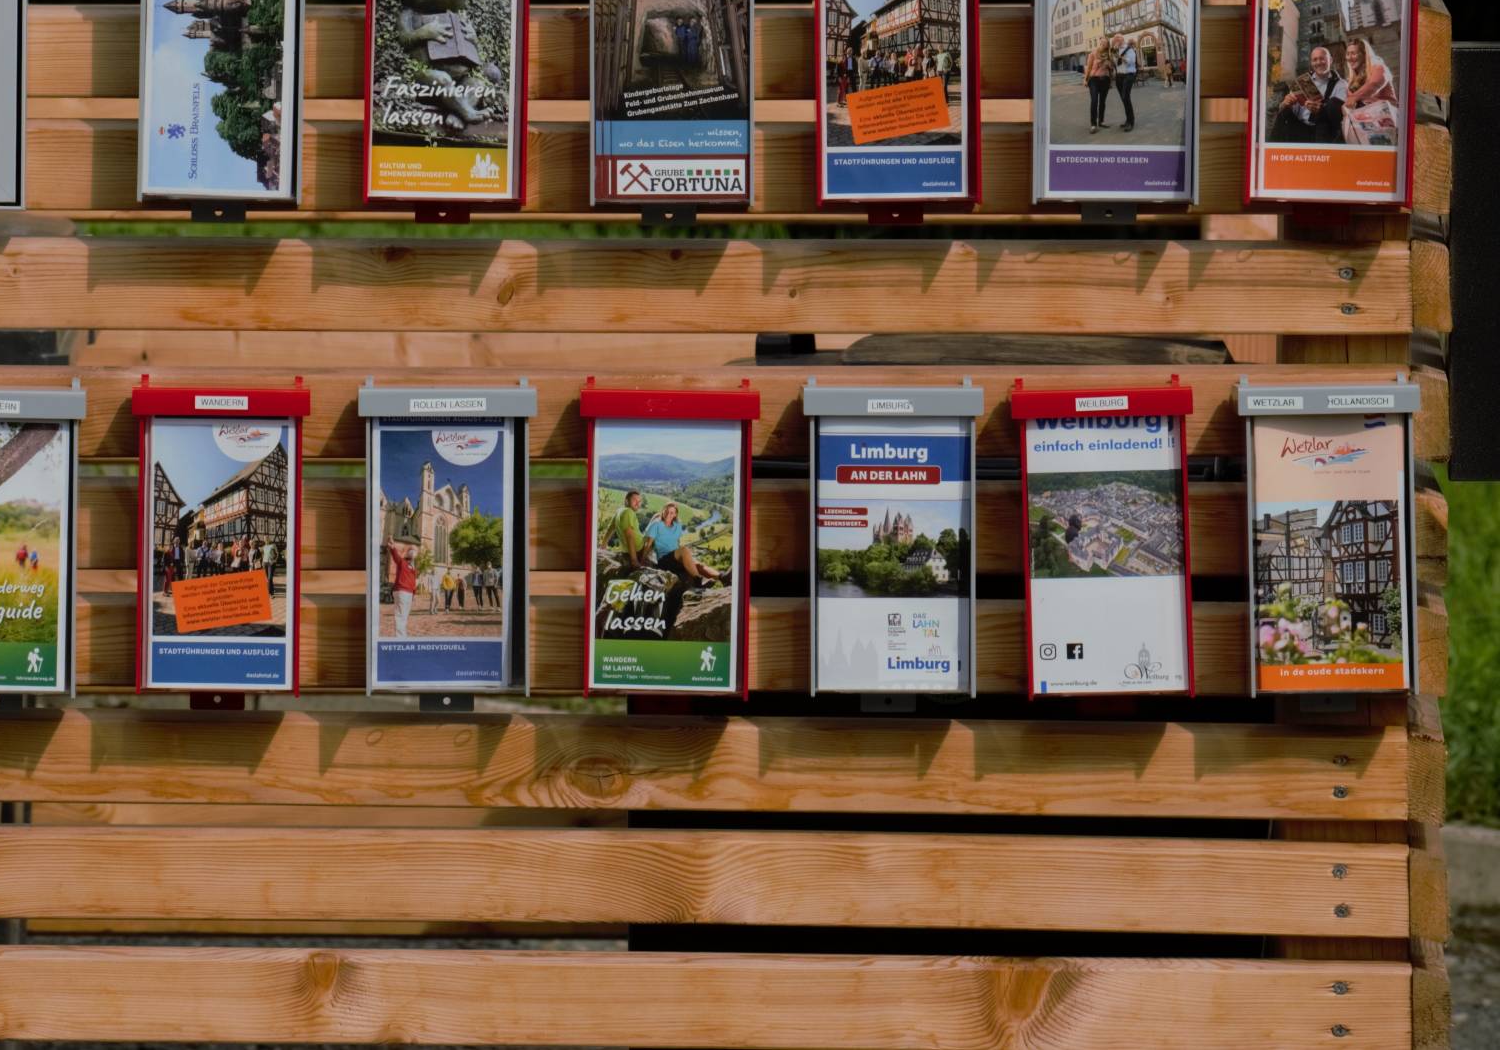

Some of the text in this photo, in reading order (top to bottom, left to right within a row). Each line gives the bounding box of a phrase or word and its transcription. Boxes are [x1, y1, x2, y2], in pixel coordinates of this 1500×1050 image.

[381, 75, 497, 99] Faszinieren
[623, 83, 684, 99] Kindergeburtstage
[625, 85, 725, 109] Feld- und Grubenbahnmuseum
[683, 91, 739, 108] Zum Zechenhaus
[382, 101, 444, 126] lassen
[707, 128, 742, 138] wissen,
[636, 137, 743, 148] das Eisen herkommt.
[834, 157, 956, 166] STADTFÜHRUNGEN UND AUSFLÜGE
[1056, 156, 1149, 164] ENTDECKEN UND ERLEBEN
[1271, 154, 1331, 163] IN DER ALTSTADT
[379, 162, 422, 170] KULTUR UND
[654, 169, 685, 177] GRUBE
[650, 177, 743, 192] FORTUNA
[200, 398, 245, 407] WANDERN
[413, 400, 483, 409] ROLLEN LASSEN
[871, 401, 910, 410] LIMBURG
[1078, 398, 1124, 409] WEILBURG
[1252, 399, 1295, 407] WETZLAR
[1033, 437, 1163, 452] einfach einladend!
[1280, 436, 1333, 458] Wetzlar
[850, 443, 929, 463] Limburg
[850, 470, 927, 481] AN DER LAHN
[605, 580, 666, 605] Gehen
[604, 610, 667, 631] lassen
[912, 612, 927, 620] DAS
[912, 619, 940, 629] LAHN
[922, 629, 941, 638] TAL
[159, 647, 279, 656] STADTFÜHRUNGEN UND AUSFLÜGE
[602, 656, 638, 664] WANDERN
[887, 655, 951, 673] Limburg
[455, 669, 499, 677] daslahntal.de
[602, 664, 645, 672] IM LAHNTAL
[1292, 666, 1386, 676] de oude stadskern
